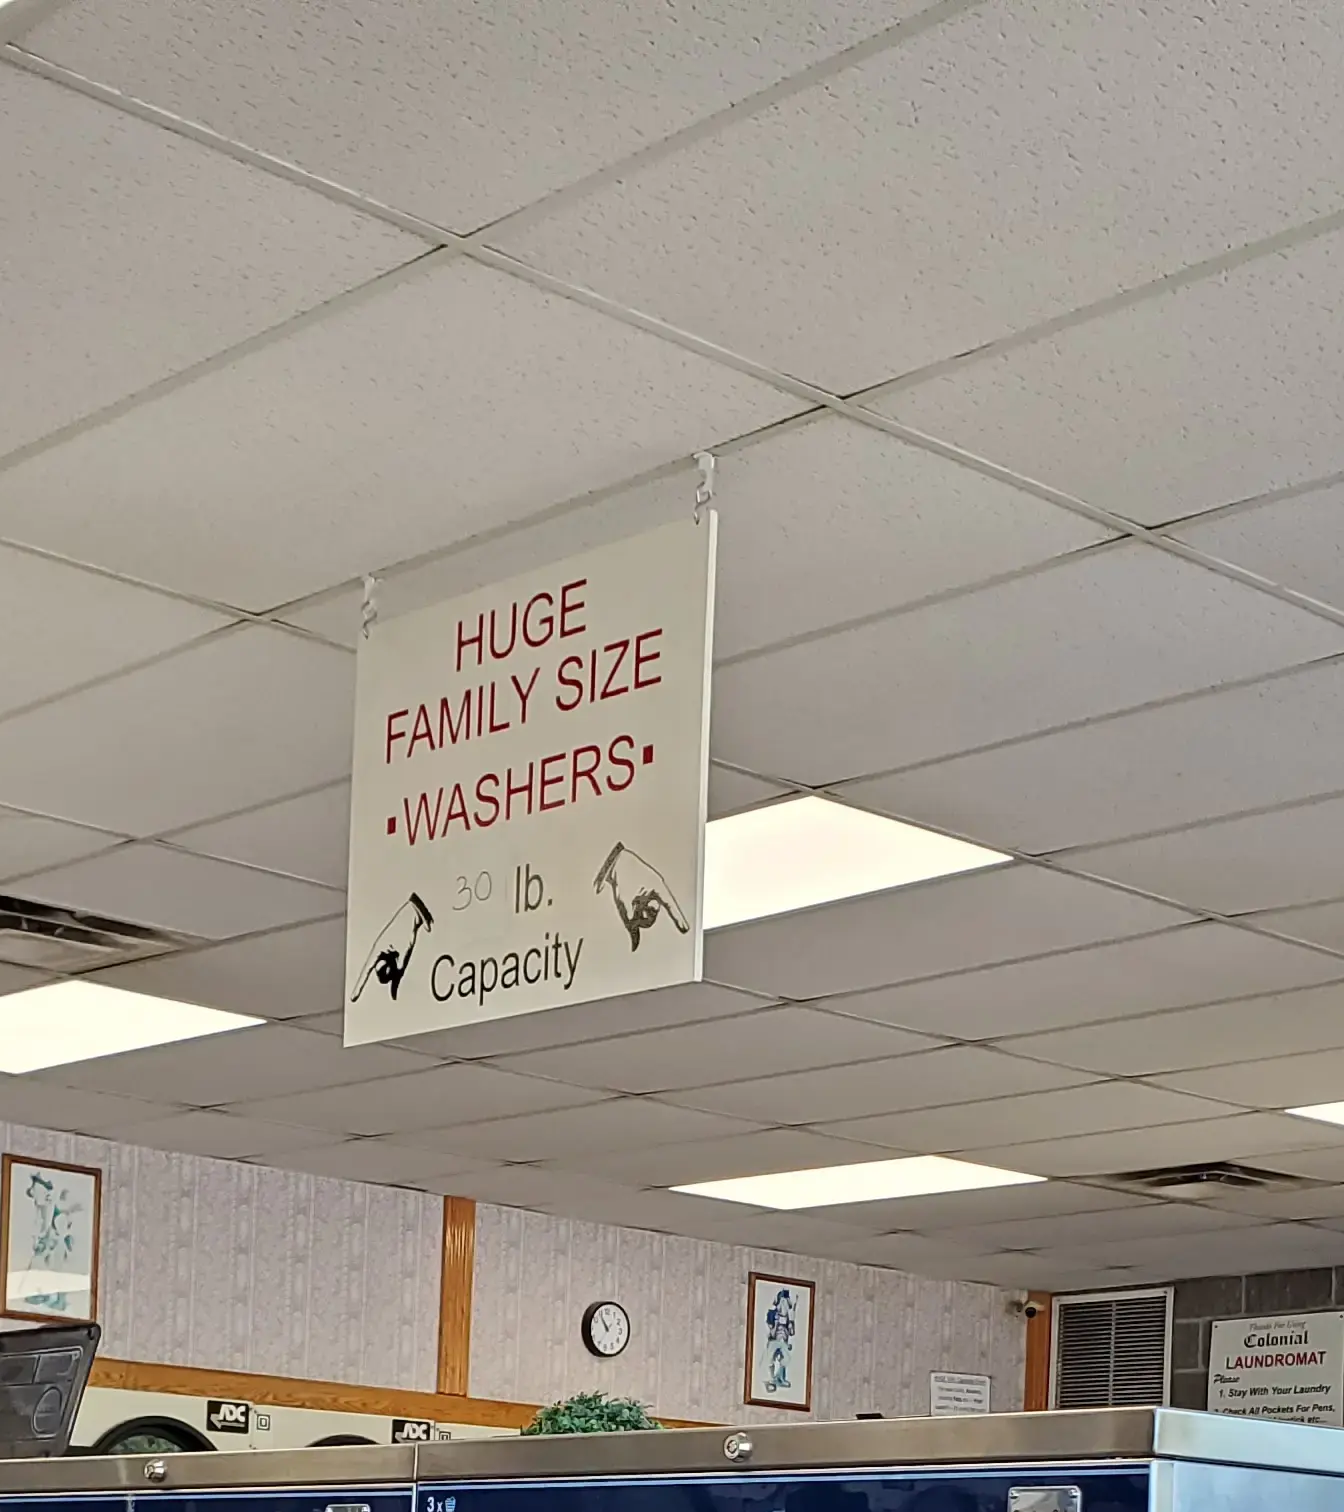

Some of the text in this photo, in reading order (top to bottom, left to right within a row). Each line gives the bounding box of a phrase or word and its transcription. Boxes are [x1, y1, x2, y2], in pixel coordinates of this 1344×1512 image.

[456, 579, 587, 671] HUGE
[385, 629, 662, 764] FAMILY SIZE
[451, 863, 552, 914] 30 lb.
[430, 933, 583, 1005] Capacity
[1244, 1330, 1308, 1348] Colonial
[1226, 1351, 1326, 1369] LAUNDROMAT
[1228, 1388, 1248, 1399] Stay
[1249, 1387, 1268, 1396] With
[1272, 1386, 1292, 1395] Your
[1293, 1384, 1331, 1395] Laundry
[217, 1403, 246, 1423] ADC
[1262, 1406, 1294, 1414] Pockets
[1296, 1404, 1310, 1412] For
[1312, 1404, 1335, 1412] Pens,
[402, 1423, 428, 1440] ADC
[427, 1497, 435, 1512] 3
